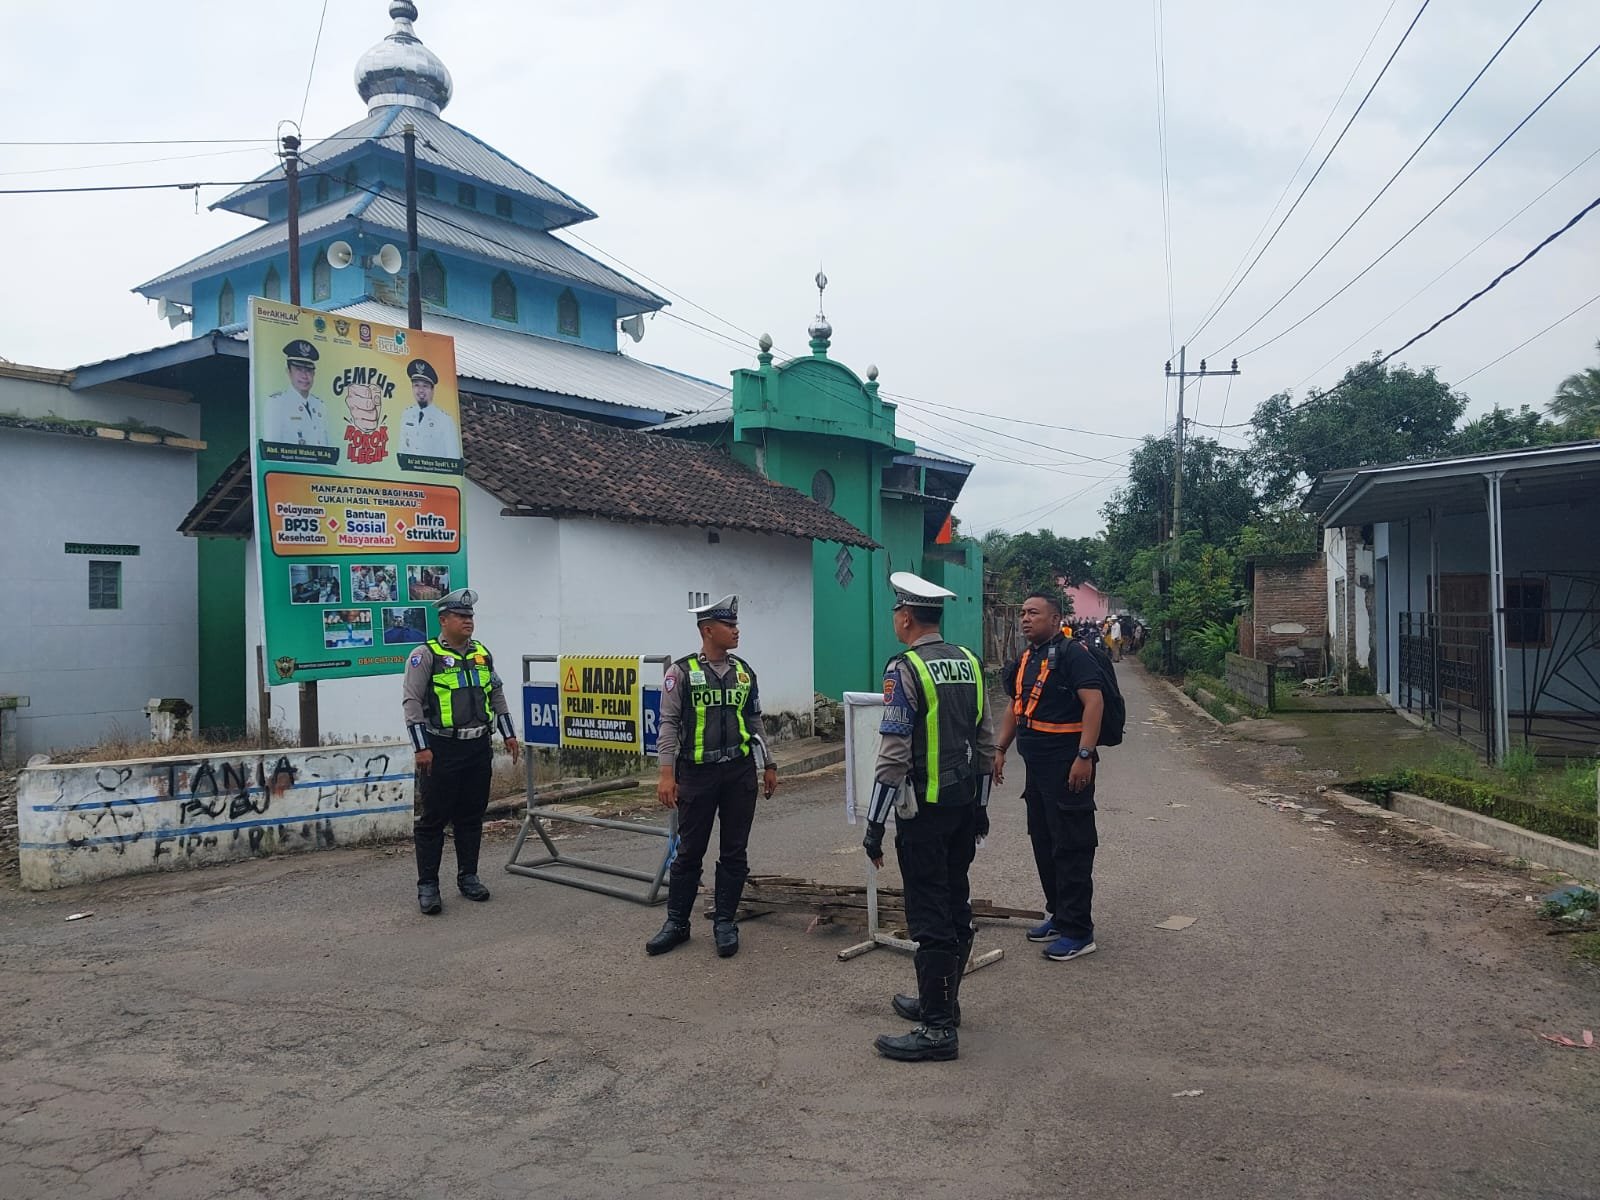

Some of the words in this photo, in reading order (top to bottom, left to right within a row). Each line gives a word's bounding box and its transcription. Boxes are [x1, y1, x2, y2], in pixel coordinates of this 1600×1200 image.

[257, 306, 300, 322] BerAKHLAK
[333, 366, 396, 399] GEMPUR
[344, 425, 389, 448] ROKOK
[347, 444, 389, 464] ILEGAL
[311, 484, 354, 494] MANFAAT
[356, 487, 380, 496] DANA
[382, 488, 403, 497] BAGI
[403, 490, 425, 499] HASIL
[317, 495, 344, 504] CUKAI
[345, 496, 370, 505] HASIL
[373, 498, 416, 507] TEMBAKAU
[277, 504, 324, 516] Pelayanan
[345, 509, 386, 520] Bantuan
[284, 517, 319, 532] BPJS
[346, 520, 386, 534] Sosial
[416, 514, 445, 527] Infra
[278, 532, 326, 543] Kesehatan
[338, 534, 394, 546] Masyarakat
[406, 528, 455, 541] struktur
[929, 661, 975, 681] POLISI
[582, 667, 637, 695] HARAP
[566, 697, 594, 714] PELAN
[602, 698, 631, 716] PELAN
[571, 717, 596, 730] JALAN
[597, 719, 626, 731] SEMPIT
[567, 728, 584, 739] DAN
[584, 729, 633, 742] BERLUBANG
[151, 755, 298, 798] TANIA
